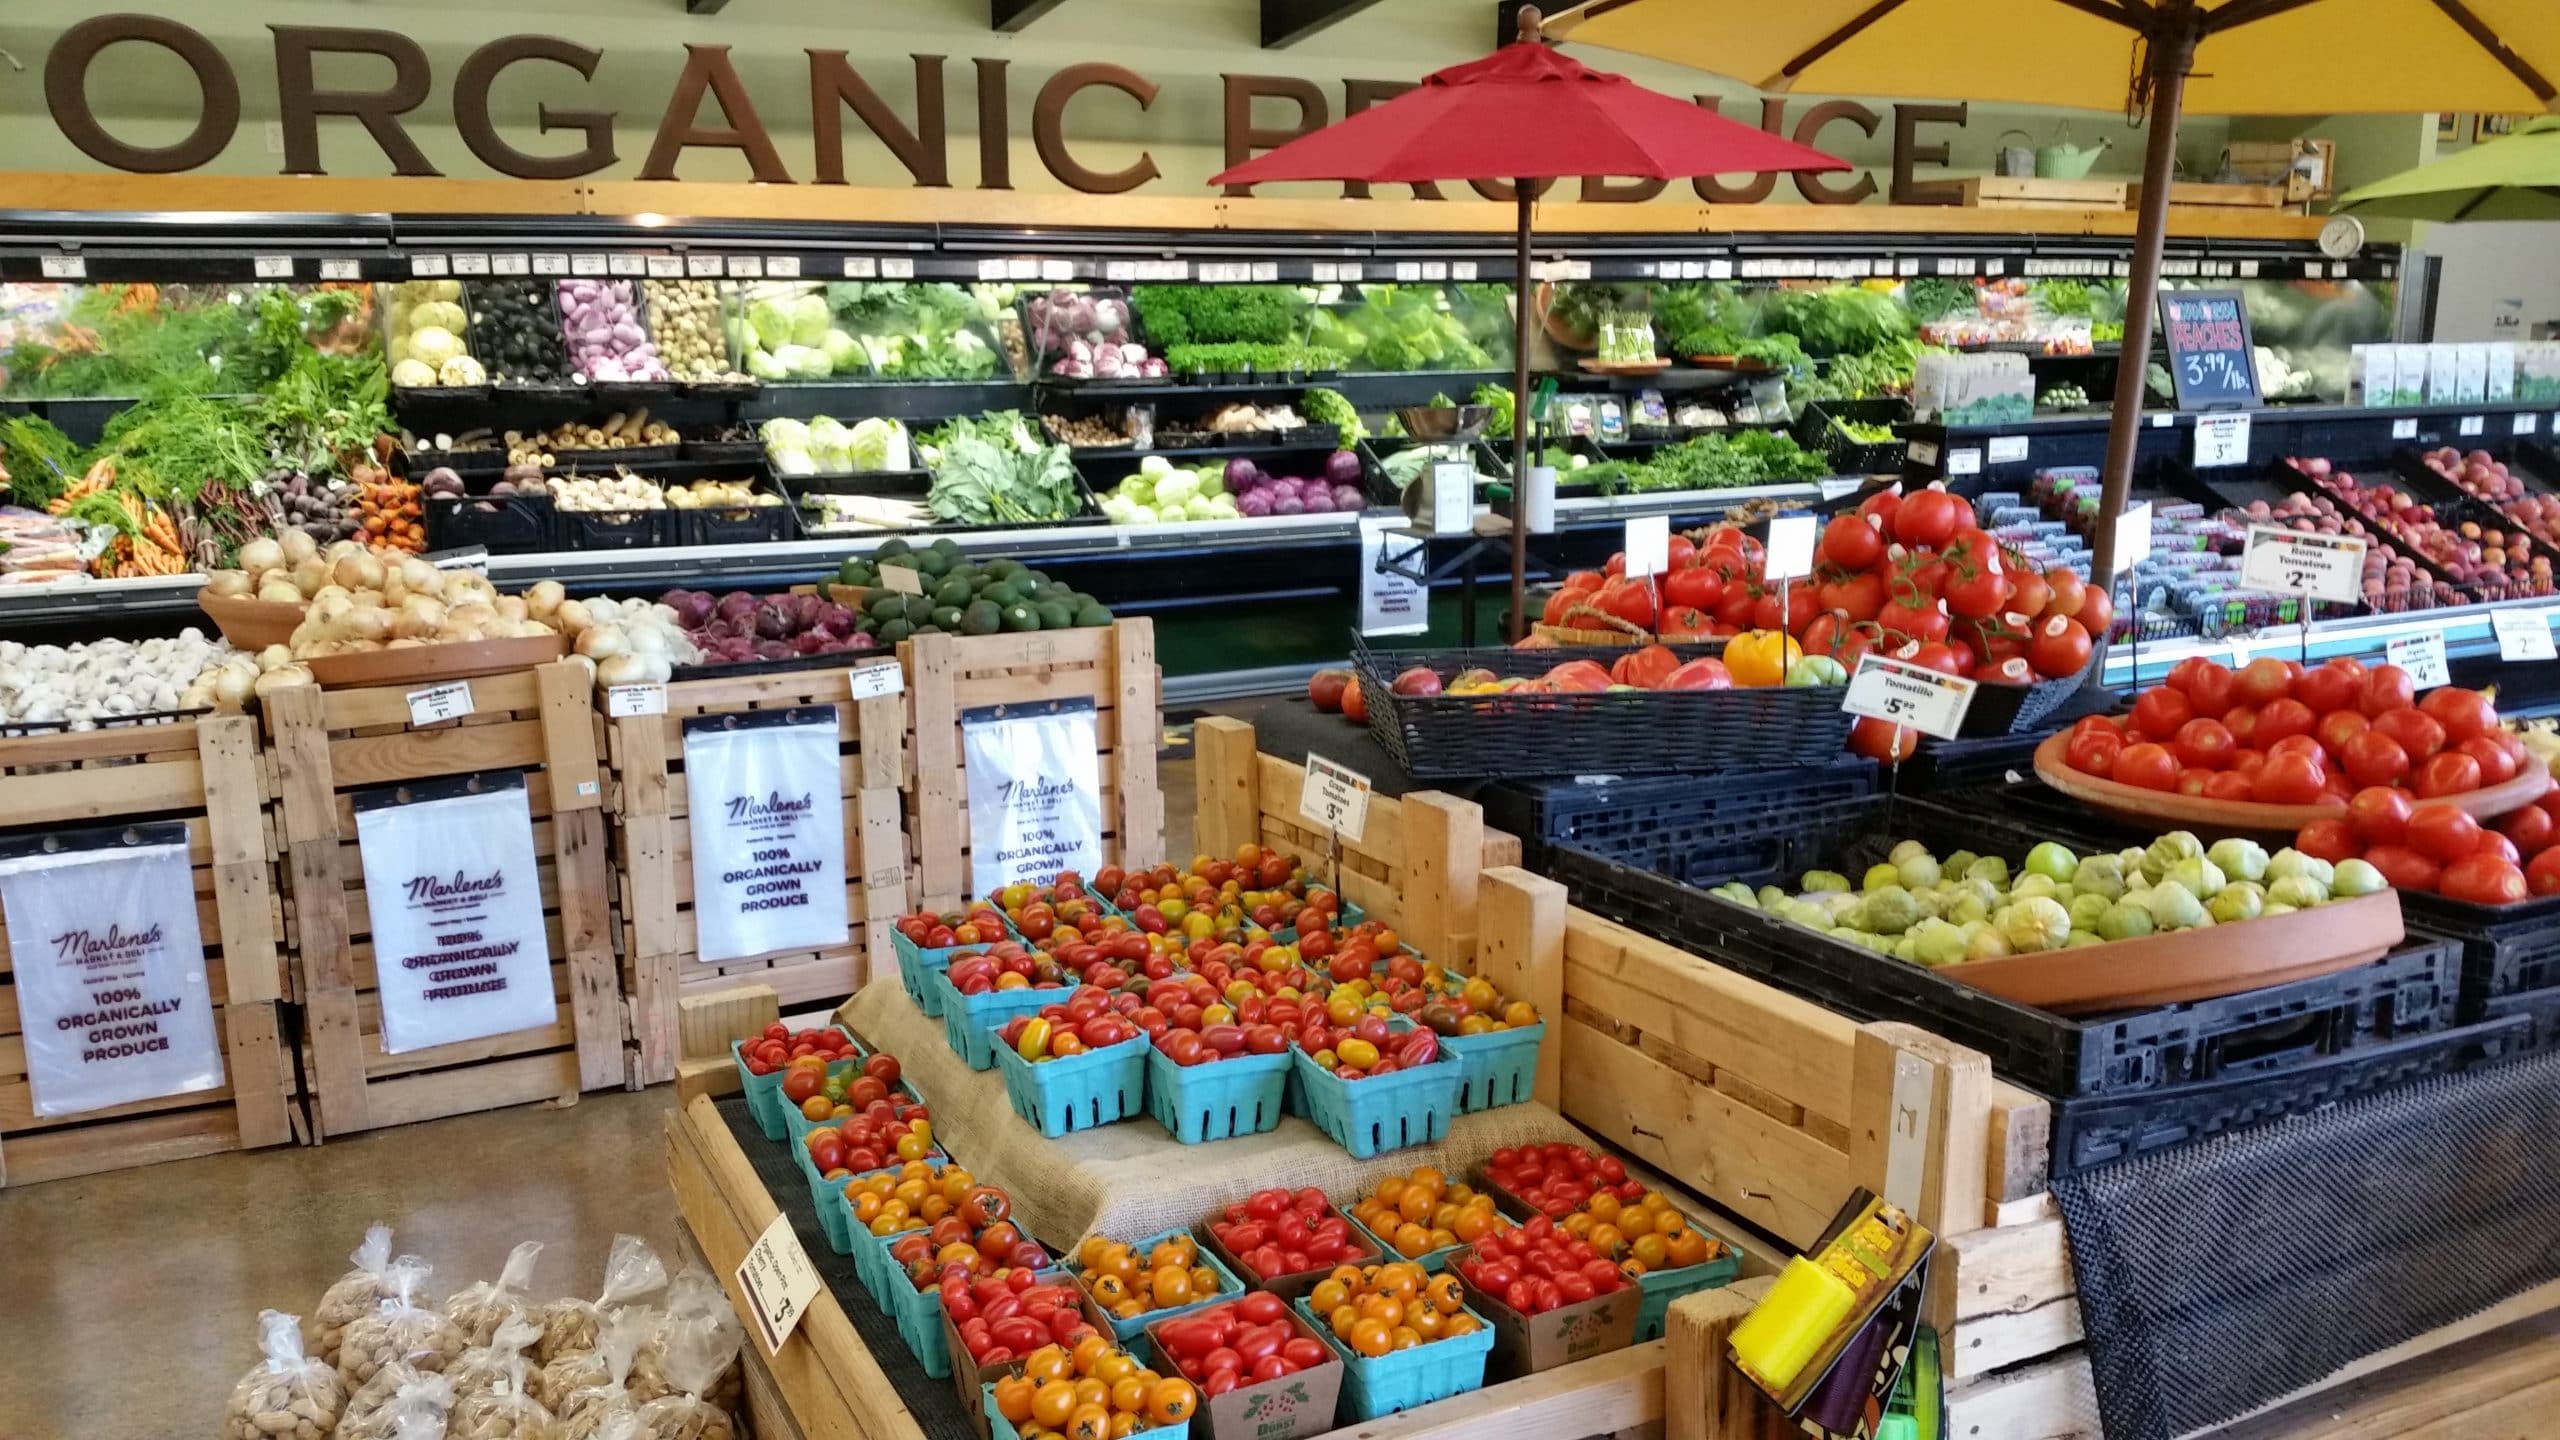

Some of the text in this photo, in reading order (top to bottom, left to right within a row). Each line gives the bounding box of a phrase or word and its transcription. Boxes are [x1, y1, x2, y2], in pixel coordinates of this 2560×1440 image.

[44, 13, 1967, 206] ORGANIC PUCE
[2171, 320, 2243, 352] PEACHES
[2279, 556, 2332, 570] Tomatoes
[2291, 547, 2322, 558] Roma
[1885, 677, 1934, 697] Tomatillo
[997, 776, 1074, 801] Marlene's
[725, 791, 811, 818] Marlene's
[1023, 829, 1055, 842] 100%
[752, 848, 790, 862] 100%
[997, 840, 1083, 862] ORGANICALLY
[723, 860, 822, 884] ORGANICALLY
[1017, 858, 1064, 873] GROWN
[402, 869, 504, 901] Marlene's
[746, 879, 801, 896] GROWN
[741, 893, 809, 913] PRODUCE
[51, 923, 163, 959] Marlene's
[93, 987, 141, 1007] 100%
[57, 998, 182, 1030] ORGANICALLY
[89, 1021, 157, 1044] GROWN
[83, 1036, 169, 1064] PRODUCE
